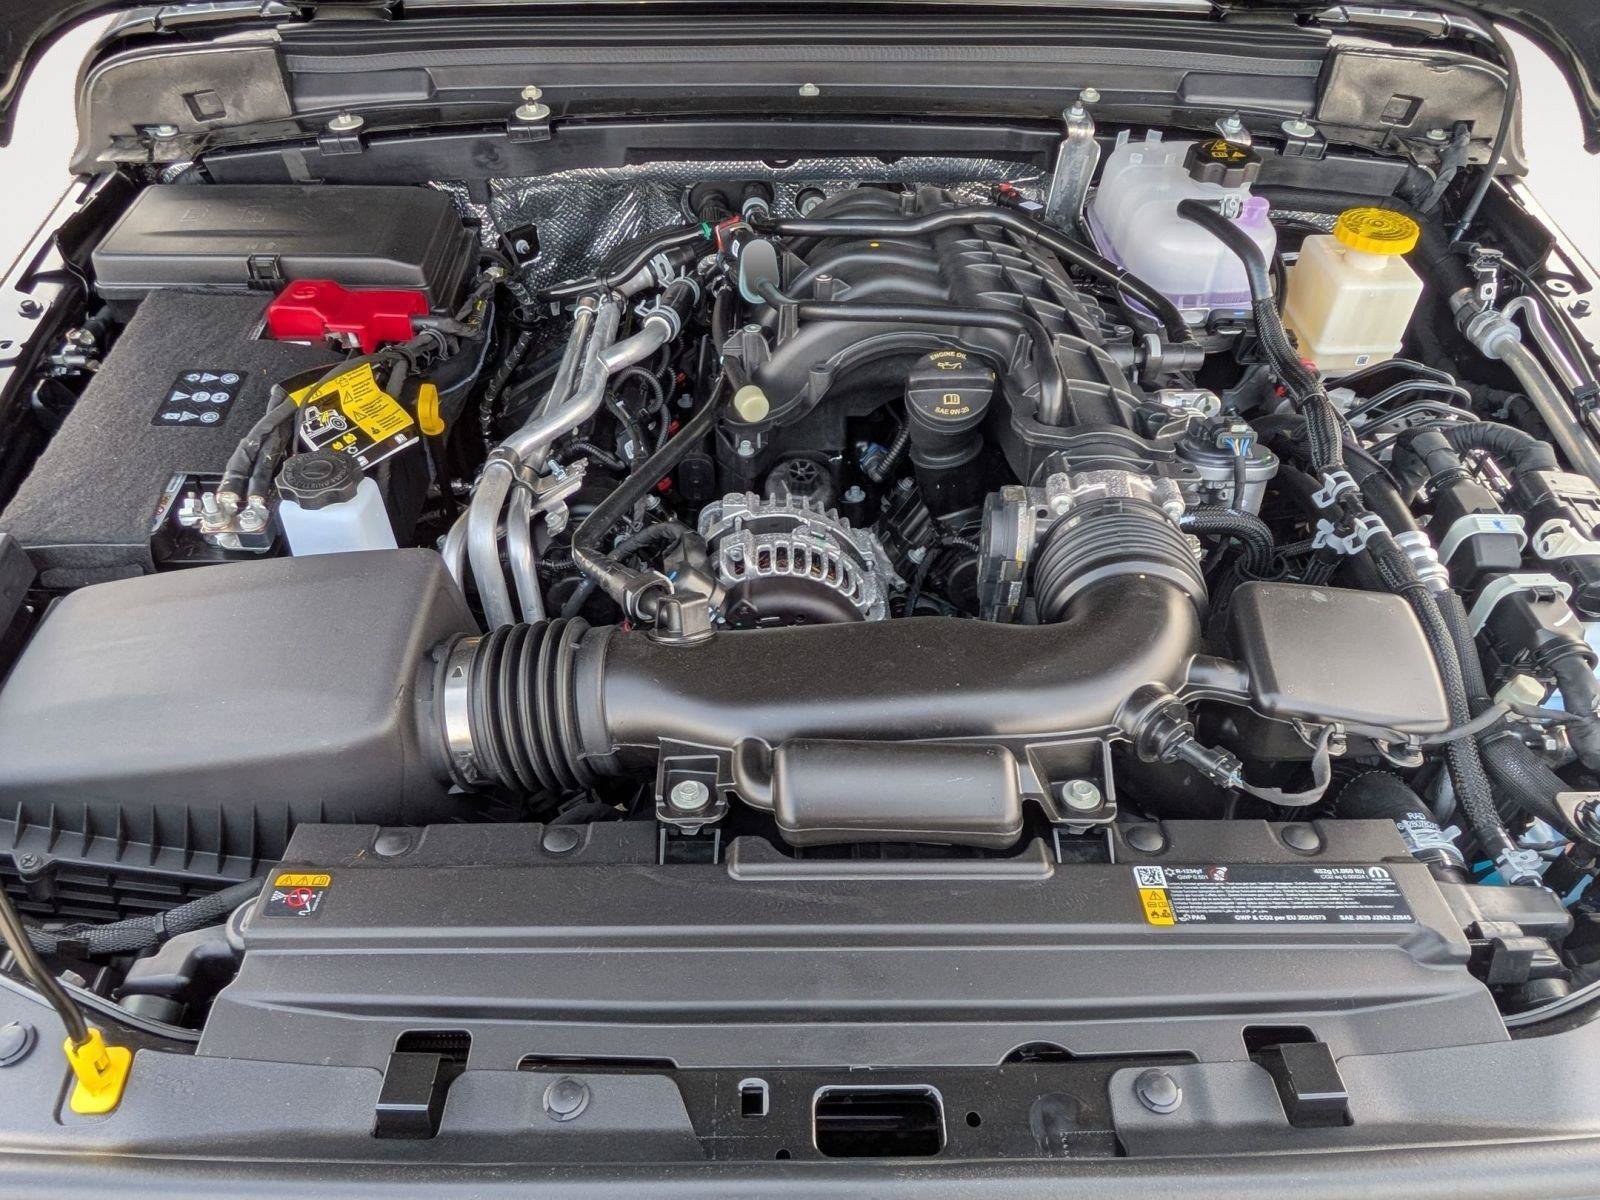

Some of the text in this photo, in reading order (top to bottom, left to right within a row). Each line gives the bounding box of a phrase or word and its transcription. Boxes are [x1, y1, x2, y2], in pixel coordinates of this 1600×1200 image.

[930, 351, 968, 360] ENGINE OIL
[1406, 812, 1426, 820] RAD
